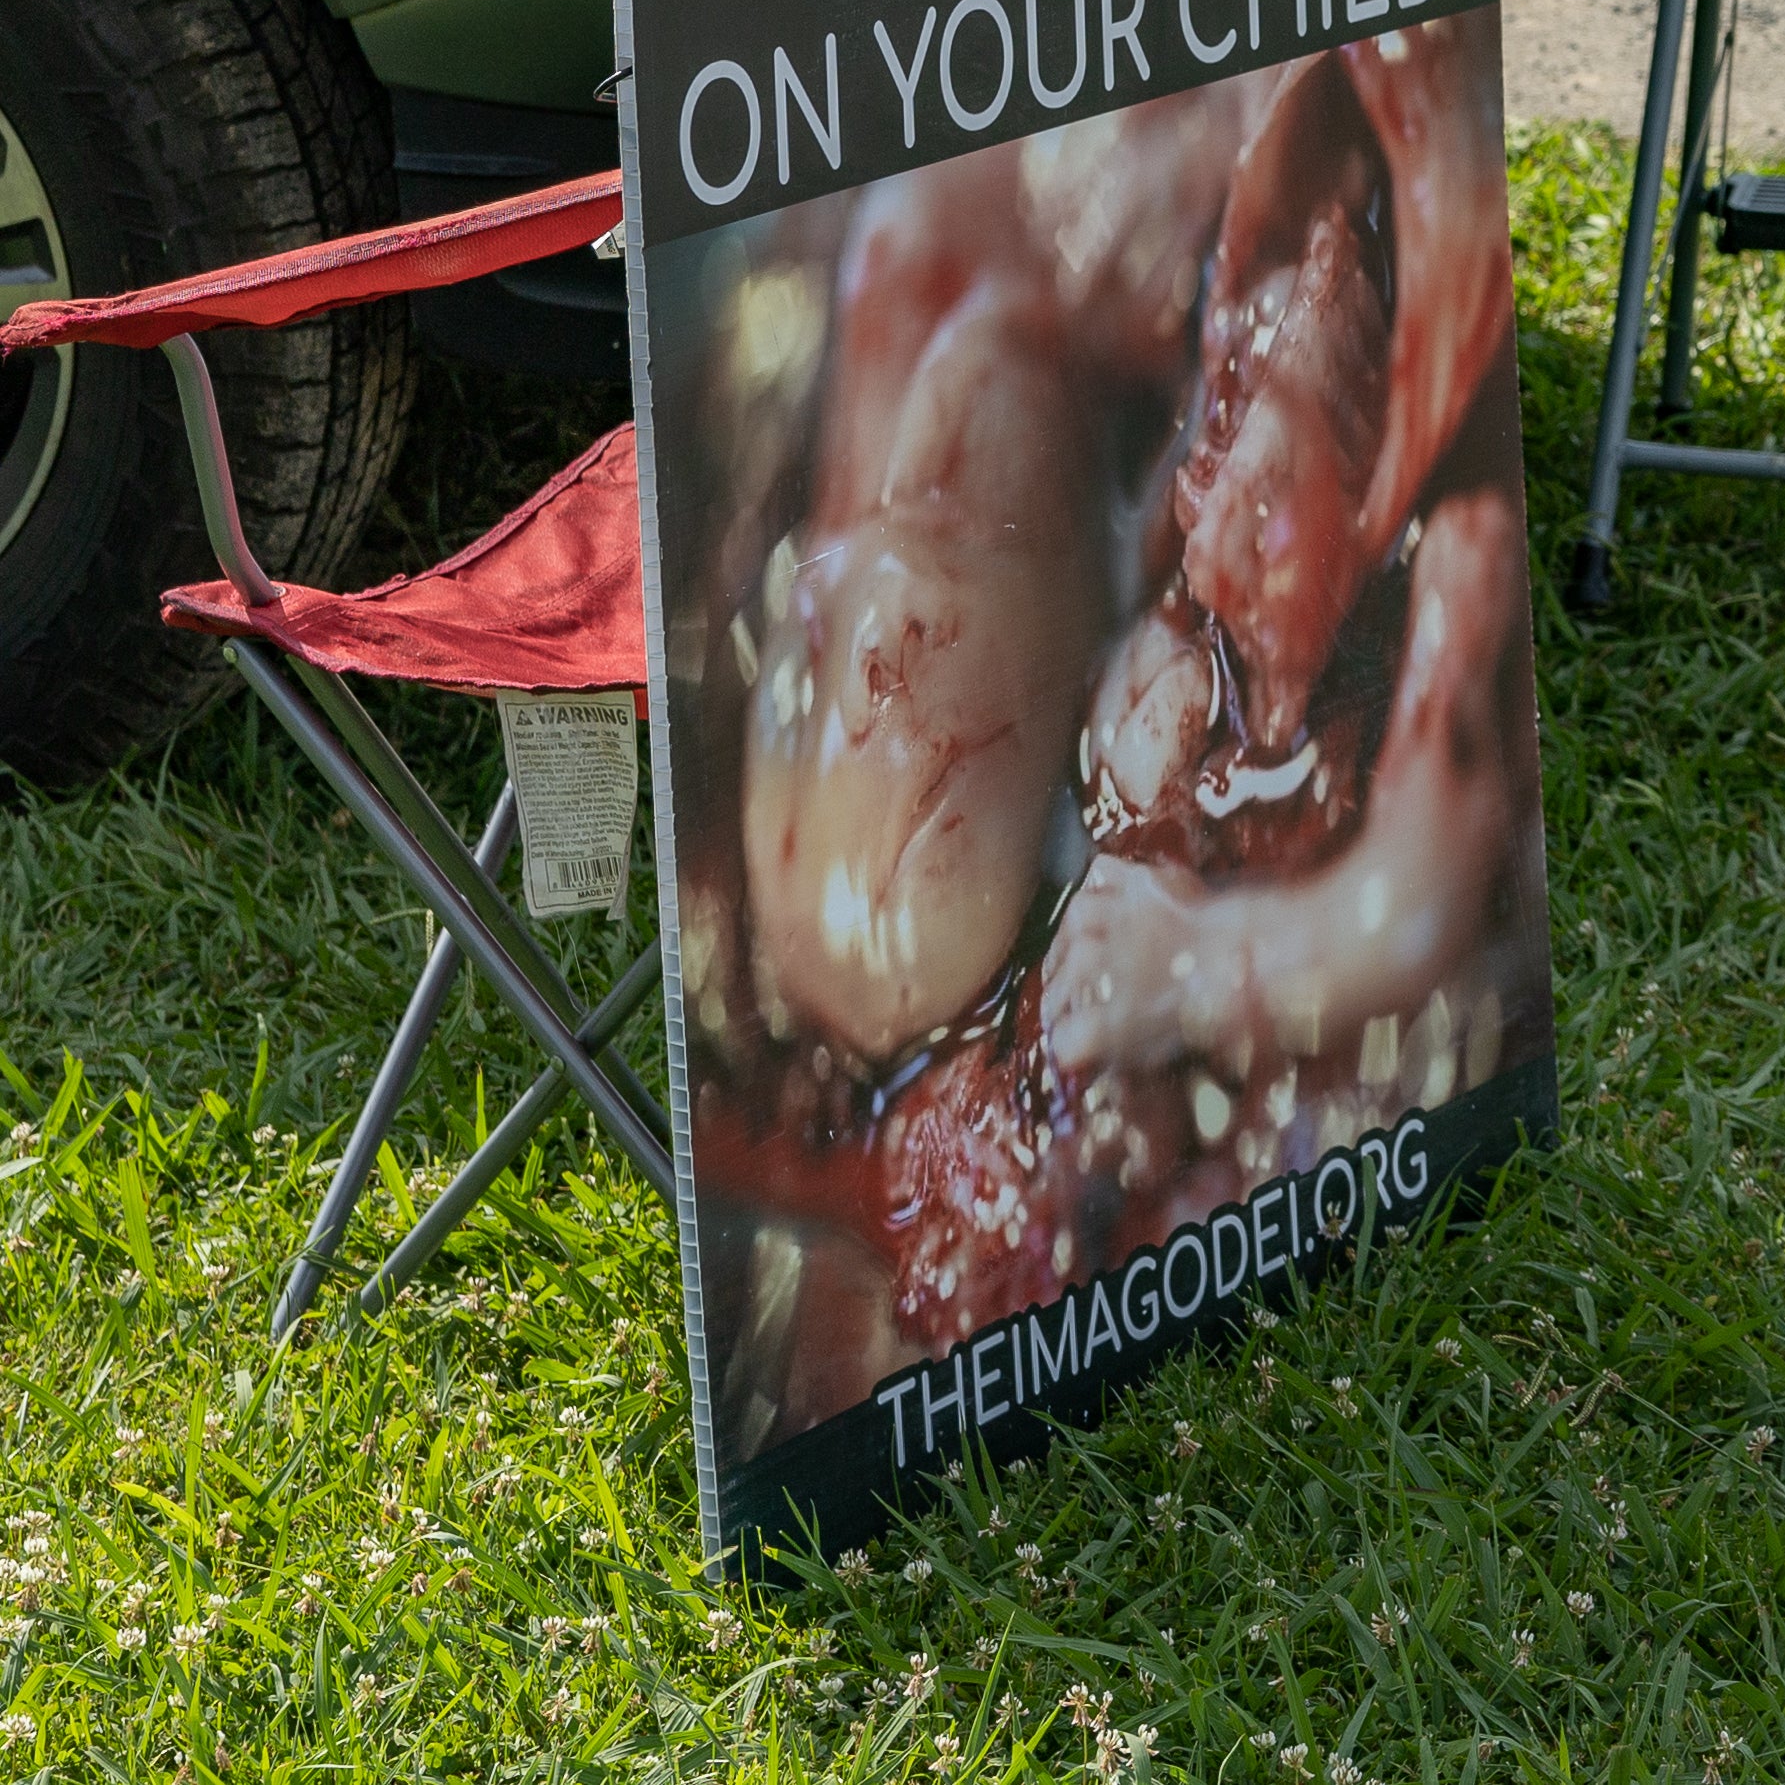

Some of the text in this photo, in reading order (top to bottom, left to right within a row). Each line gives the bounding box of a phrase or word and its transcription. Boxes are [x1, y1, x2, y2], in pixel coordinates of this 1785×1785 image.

[679, 32, 842, 207] ON
[536, 706, 630, 727] WARNING
[577, 887, 613, 899] MADE IN
[876, 1118, 1429, 1469] THEIMAGODEI.ORG
